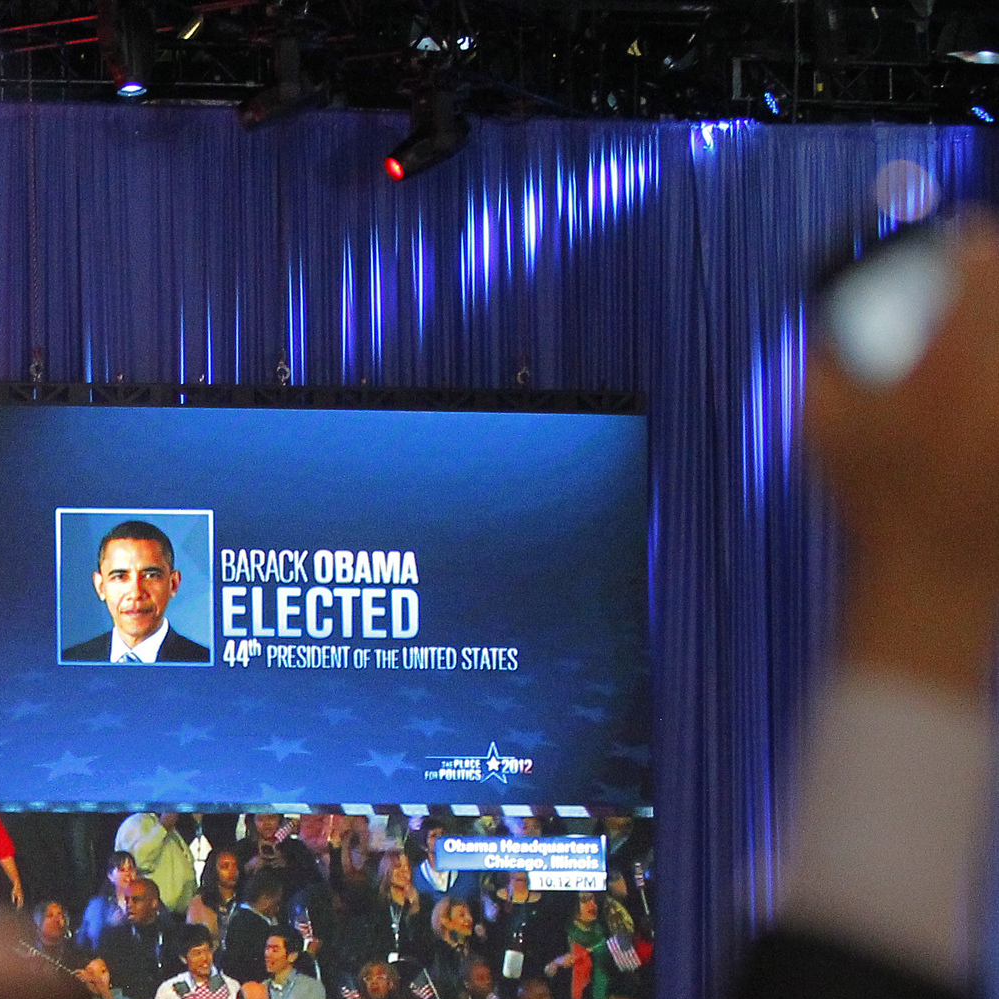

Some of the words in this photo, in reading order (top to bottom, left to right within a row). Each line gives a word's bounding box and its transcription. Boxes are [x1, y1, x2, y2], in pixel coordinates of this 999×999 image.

[221, 549, 309, 583] BARACK
[313, 549, 419, 584] OBAMA
[221, 586, 419, 639] ELECTED
[222, 638, 262, 668] 44th
[266, 644, 351, 669] PRESIDENT
[353, 649, 371, 669] OF
[374, 649, 399, 669] THE
[402, 646, 457, 670] UNITED
[461, 647, 519, 671] STATES
[453, 759, 481, 768] PLACE
[501, 758, 533, 774] 2012
[424, 770, 438, 780] FOR
[438, 769, 482, 781] POLITICS
[443, 838, 498, 853] Obama
[500, 839, 600, 856] Headquarters
[484, 855, 548, 871] Chicago,
[550, 856, 600, 870] Illinois
[575, 876, 597, 888] PM
